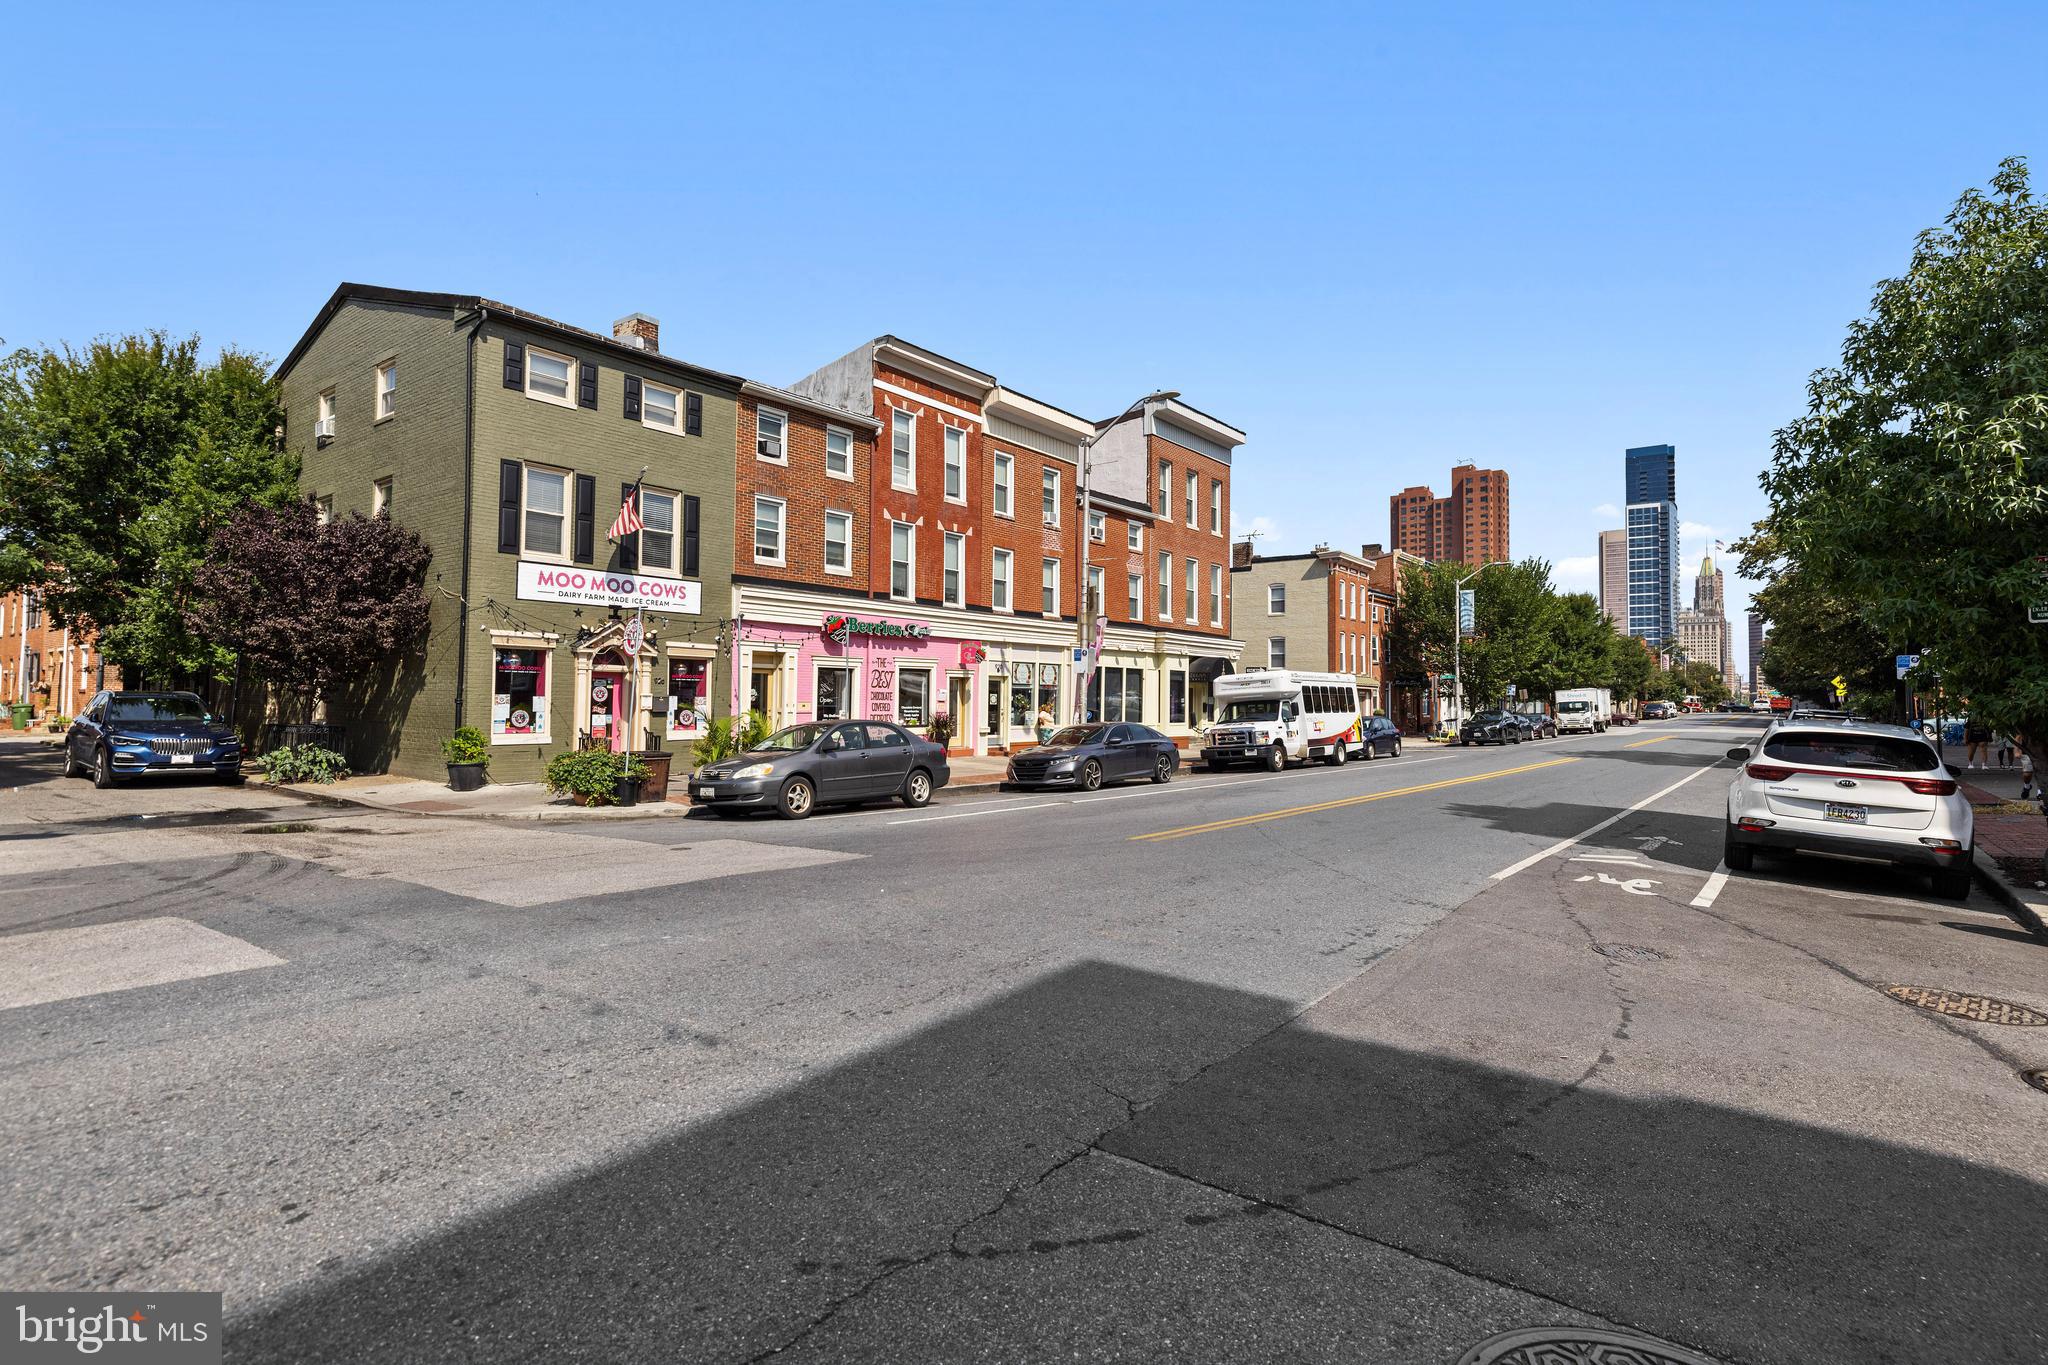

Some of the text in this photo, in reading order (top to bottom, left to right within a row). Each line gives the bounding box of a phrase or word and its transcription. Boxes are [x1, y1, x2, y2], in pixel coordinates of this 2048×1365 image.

[537, 570, 687, 600] MOO MOO COWS
[558, 590, 670, 607] DAIRY FARM MADE ICE CREAM
[848, 617, 903, 637] Berries
[876, 657, 887, 668] THE
[870, 669, 895, 689] BEST
[820, 696, 833, 705] Open
[870, 691, 893, 701] CHOCOLATE
[871, 703, 891, 712] COVERED
